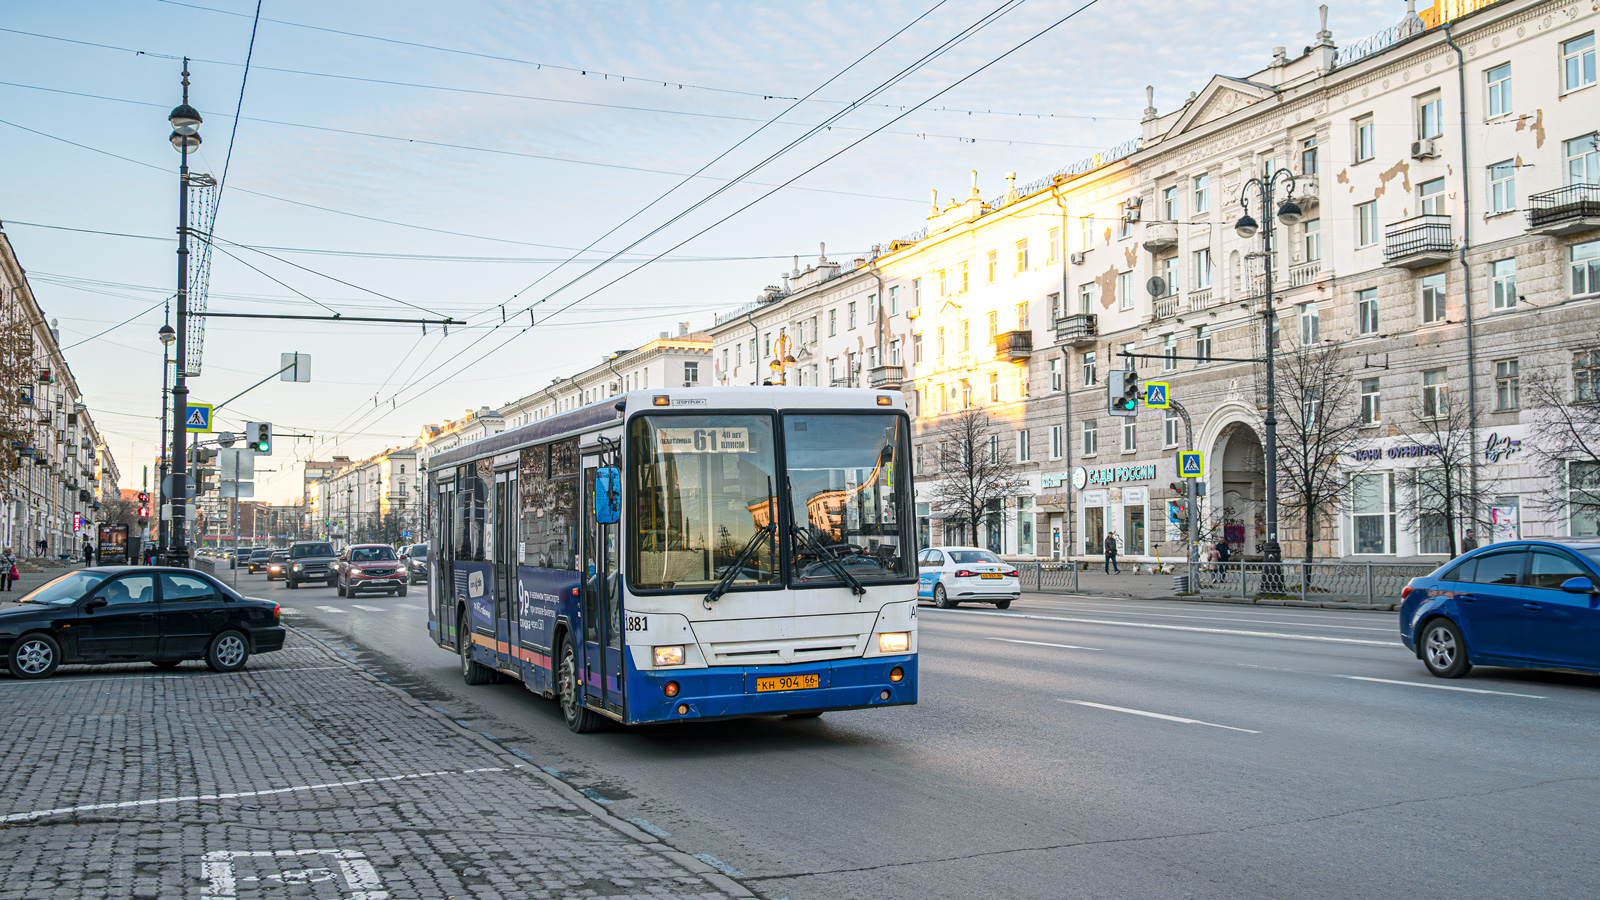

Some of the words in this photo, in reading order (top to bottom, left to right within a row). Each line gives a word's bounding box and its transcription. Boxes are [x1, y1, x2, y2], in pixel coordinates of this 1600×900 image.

[694, 429, 717, 450] 61
[721, 431, 731, 439] 40
[720, 441, 745, 449] ВЛКСМ
[1355, 448, 1382, 461] ТКАНИ
[1387, 444, 1441, 459] ФУРНИТУРА
[1088, 468, 1115, 485] САДЫ
[1117, 464, 1156, 481] РОССИИ
[762, 682, 774, 690] КН
[780, 678, 798, 688] 904
[804, 676, 814, 684] 66
